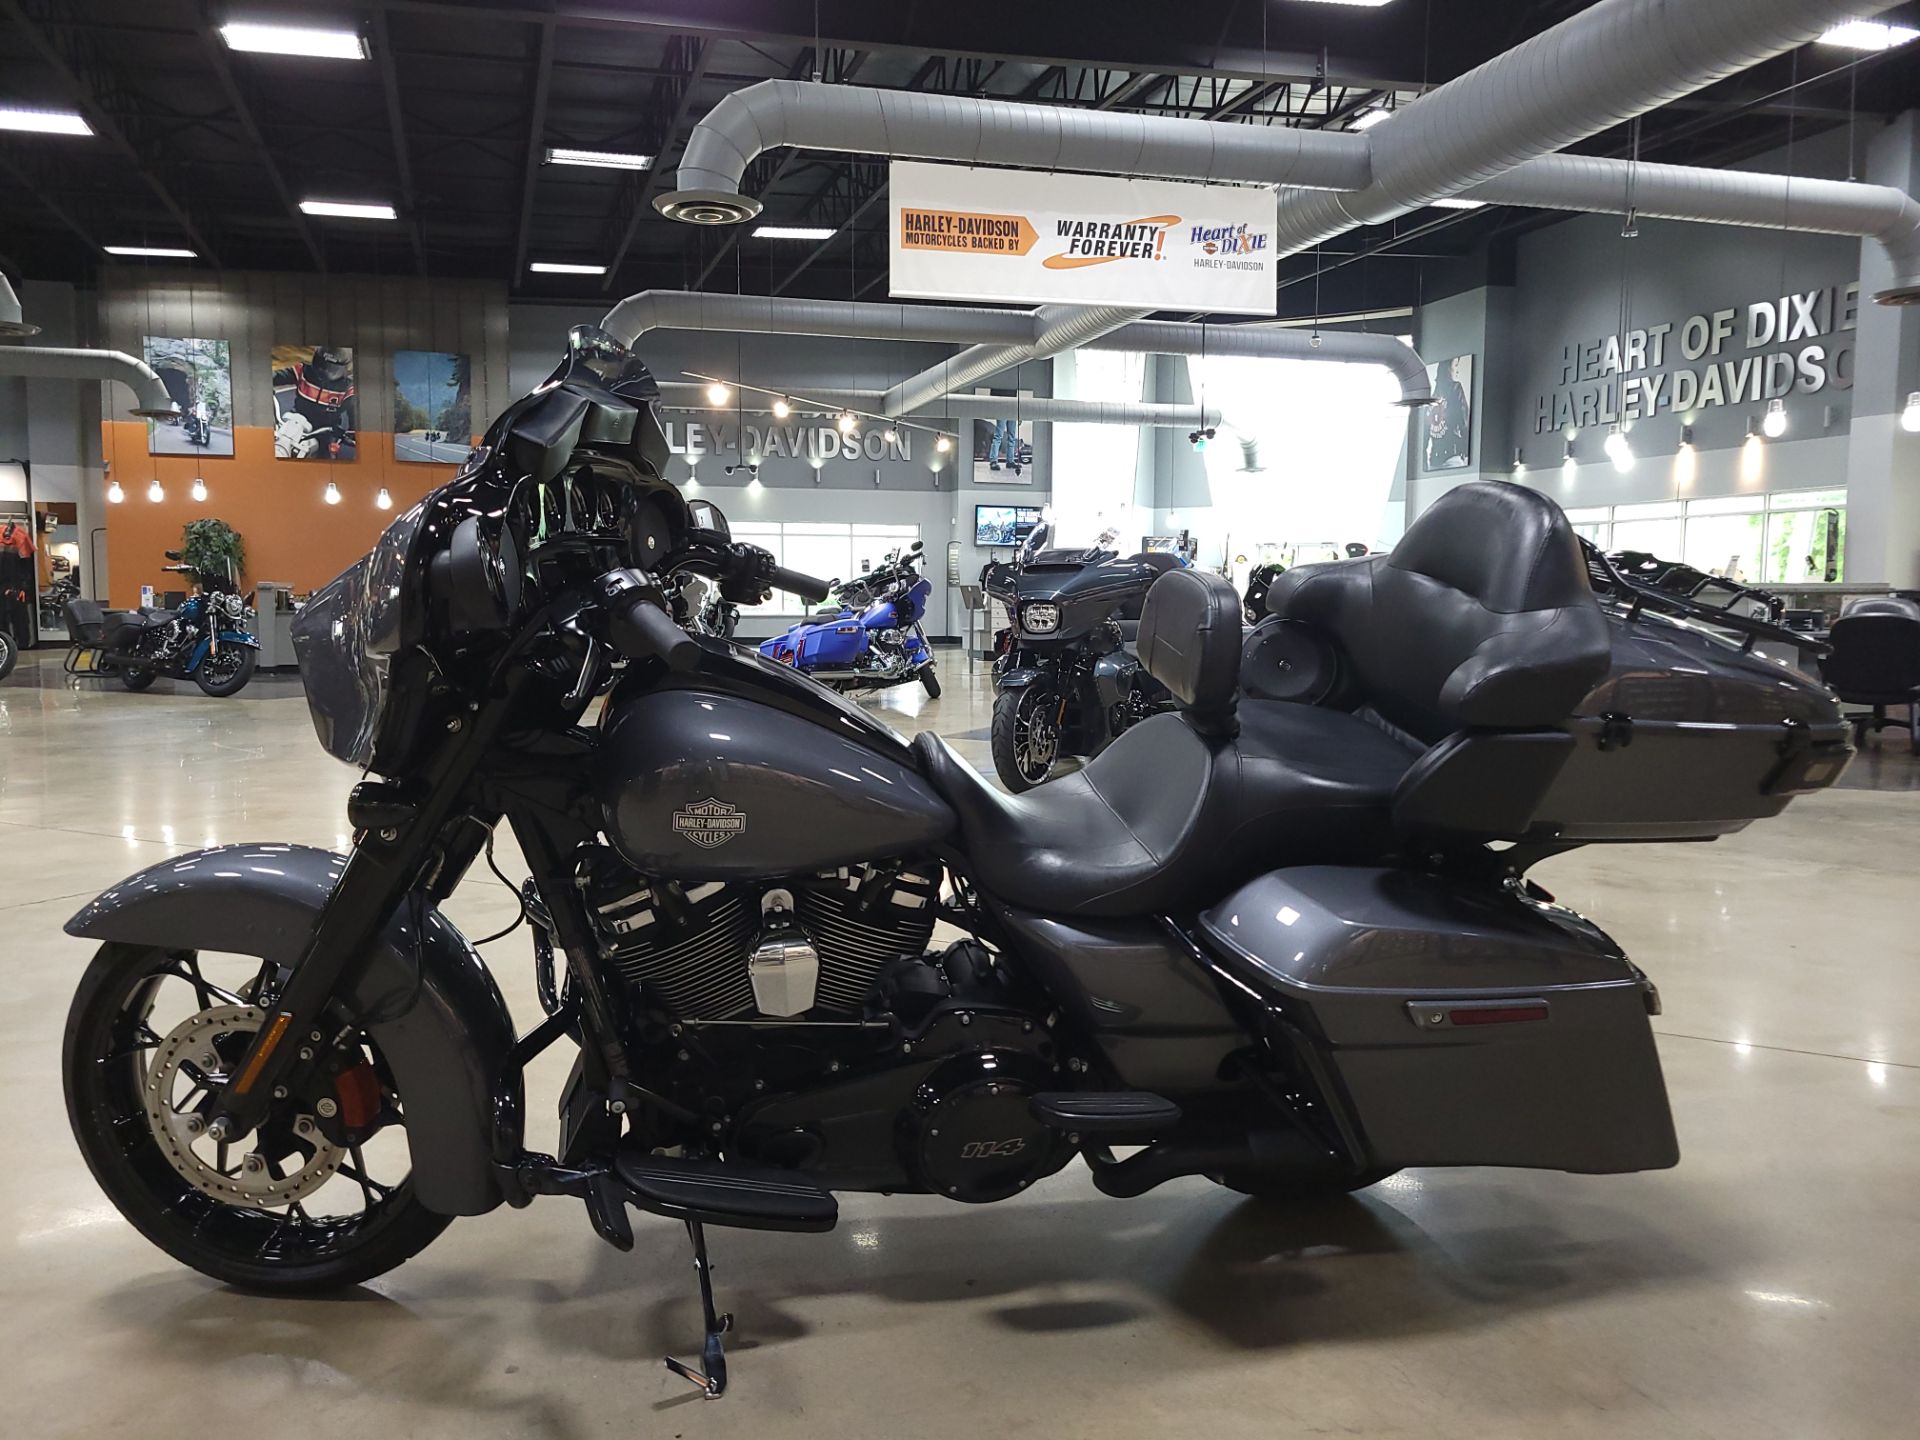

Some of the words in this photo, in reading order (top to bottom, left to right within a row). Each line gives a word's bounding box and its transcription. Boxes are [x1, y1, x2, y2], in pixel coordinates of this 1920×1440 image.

[905, 213, 1019, 238] HARLEY-DAVIDSON
[1057, 219, 1159, 242] WARRANTY
[1190, 223, 1235, 243] Heart
[1236, 223, 1248, 235] of
[905, 232, 968, 248] MOTORCYCLES
[971, 236, 1005, 250] BACKED
[1008, 239, 1020, 251] BY
[1069, 231, 1166, 261] FOREVER!
[1220, 233, 1268, 255] DIXIE
[1193, 258, 1264, 271] HARLEY-DAVIDSON
[1558, 323, 1672, 386] HEART
[1681, 308, 1736, 362] OF
[1746, 281, 1859, 349] DIXIE
[694, 804, 727, 816] MOTOR
[679, 817, 741, 829] HARLEY-DAVIDSON
[692, 831, 726, 843] CYCLES
[960, 1138, 1026, 1158] 114
